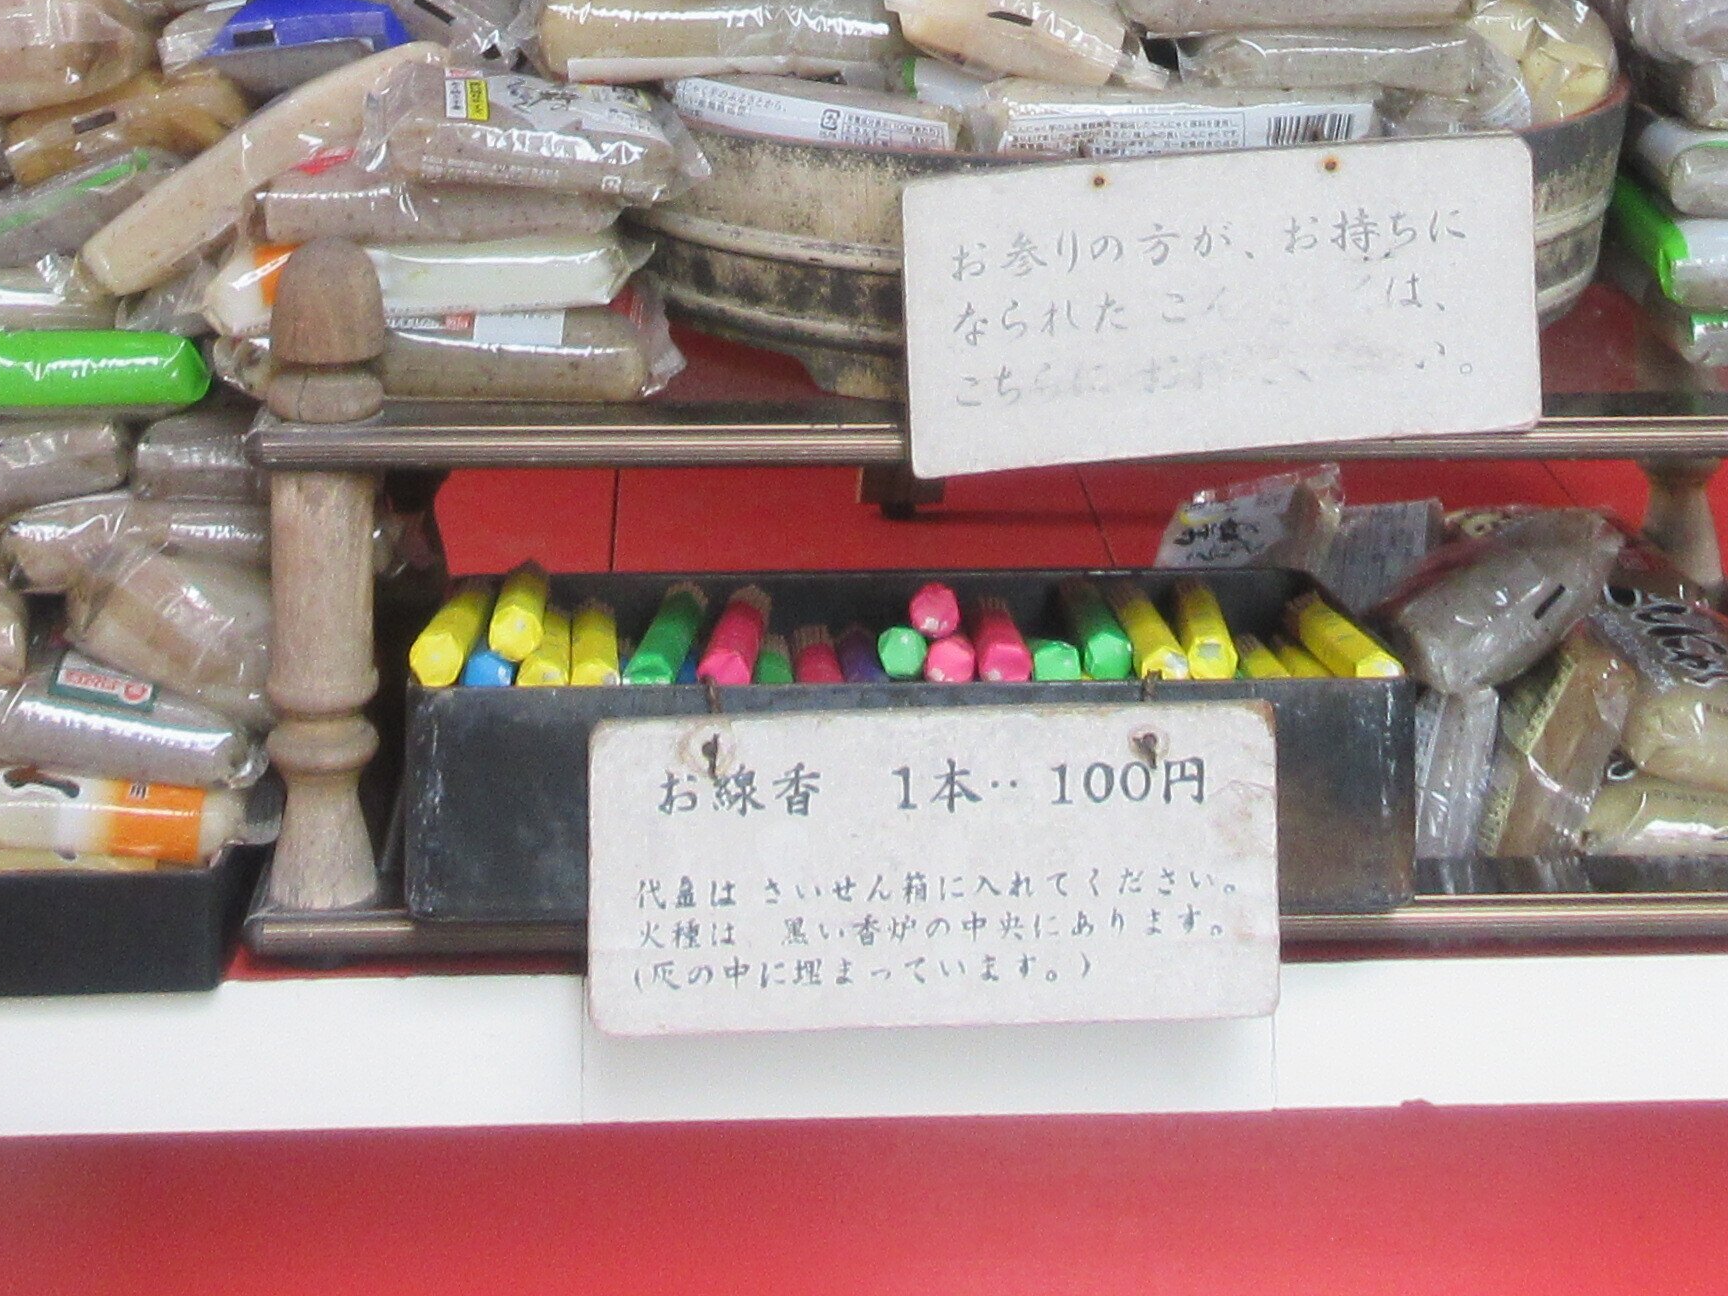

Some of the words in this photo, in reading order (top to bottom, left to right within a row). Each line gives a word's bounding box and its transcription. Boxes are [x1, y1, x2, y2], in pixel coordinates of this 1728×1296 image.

[952, 207, 1466, 282] お参りの方が、お持ちに
[658, 762, 821, 817] お線香
[1050, 757, 1206, 805] 100円
